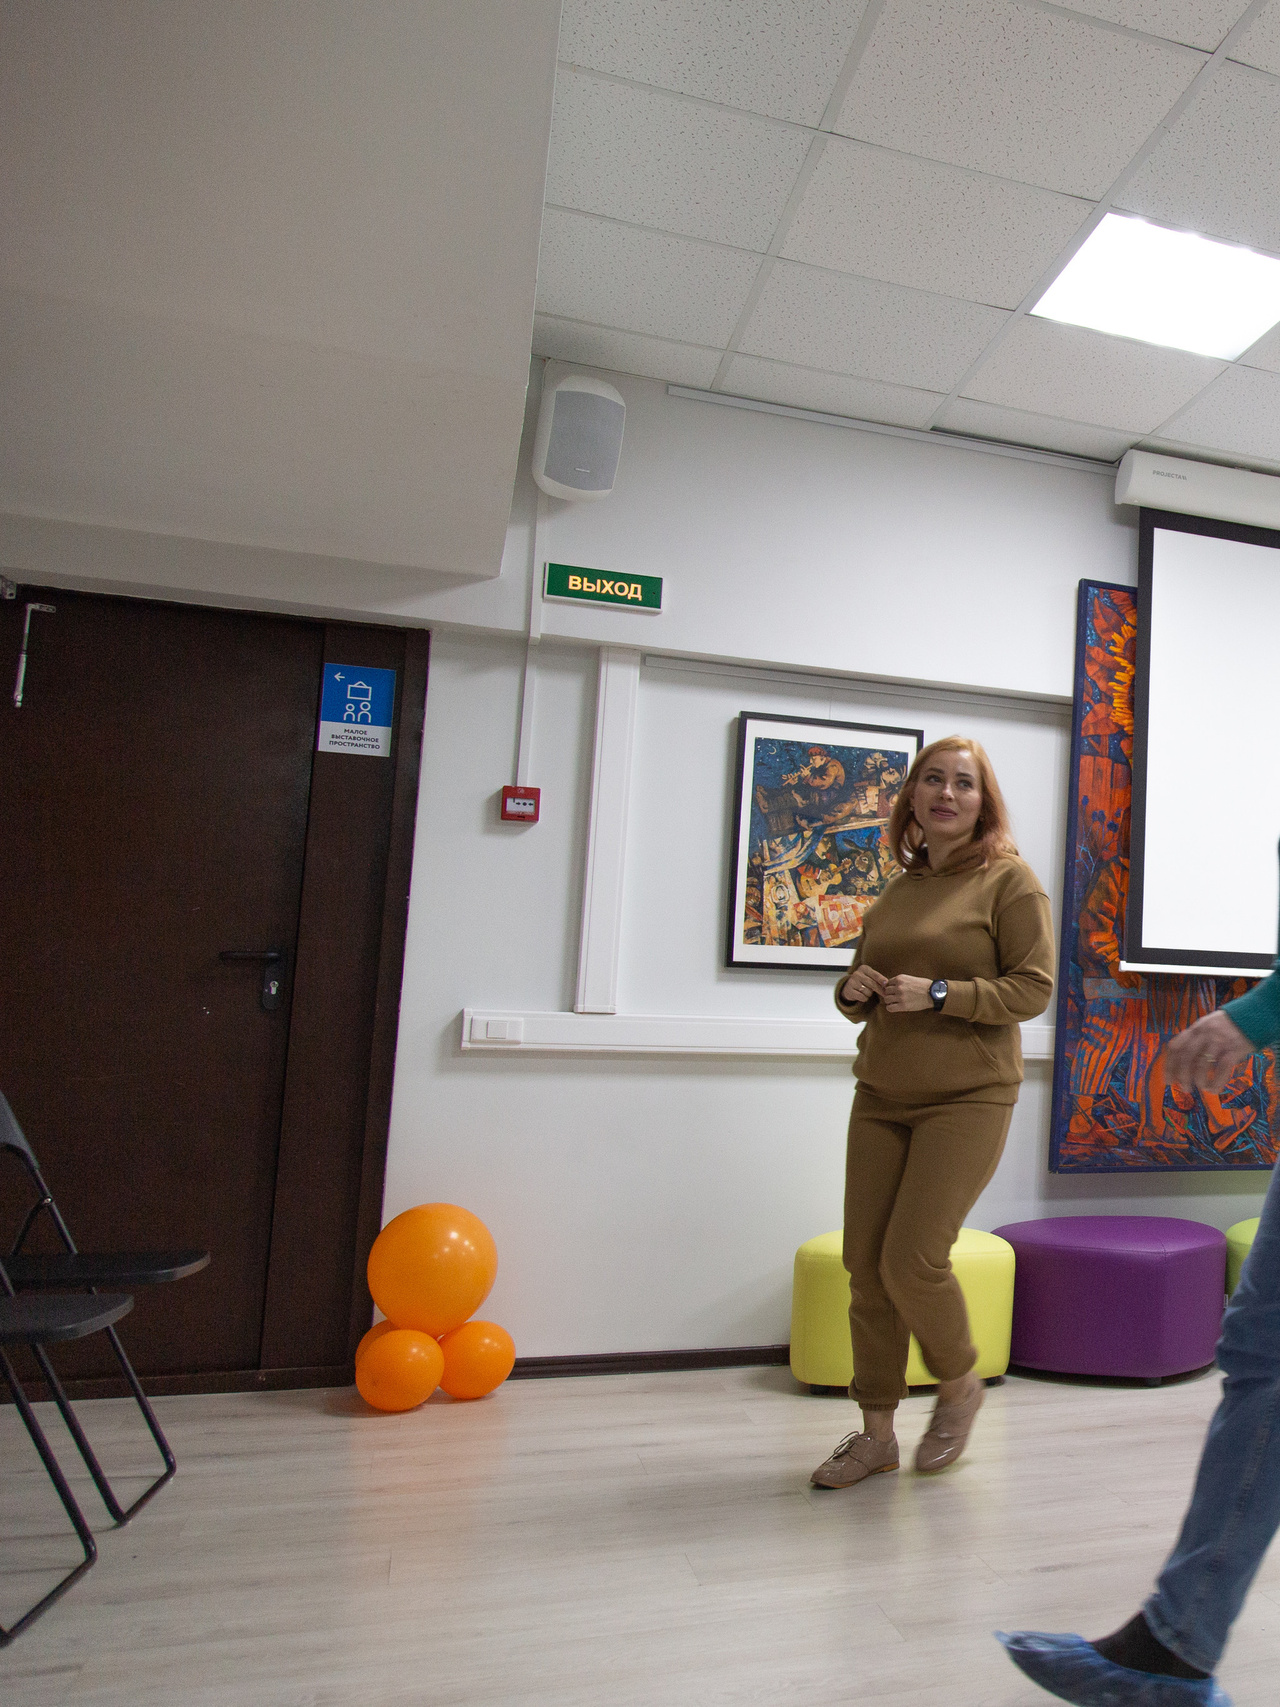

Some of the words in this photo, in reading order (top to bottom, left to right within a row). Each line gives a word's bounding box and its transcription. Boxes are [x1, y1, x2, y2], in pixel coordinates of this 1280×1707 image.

[568, 575, 643, 601] ВЫХОД
[343, 728, 368, 736] МАЛОЕ
[331, 734, 379, 743] ВЫСТАВОЧНОЕ
[328, 740, 381, 750] ПРОСТРАНСТВО
